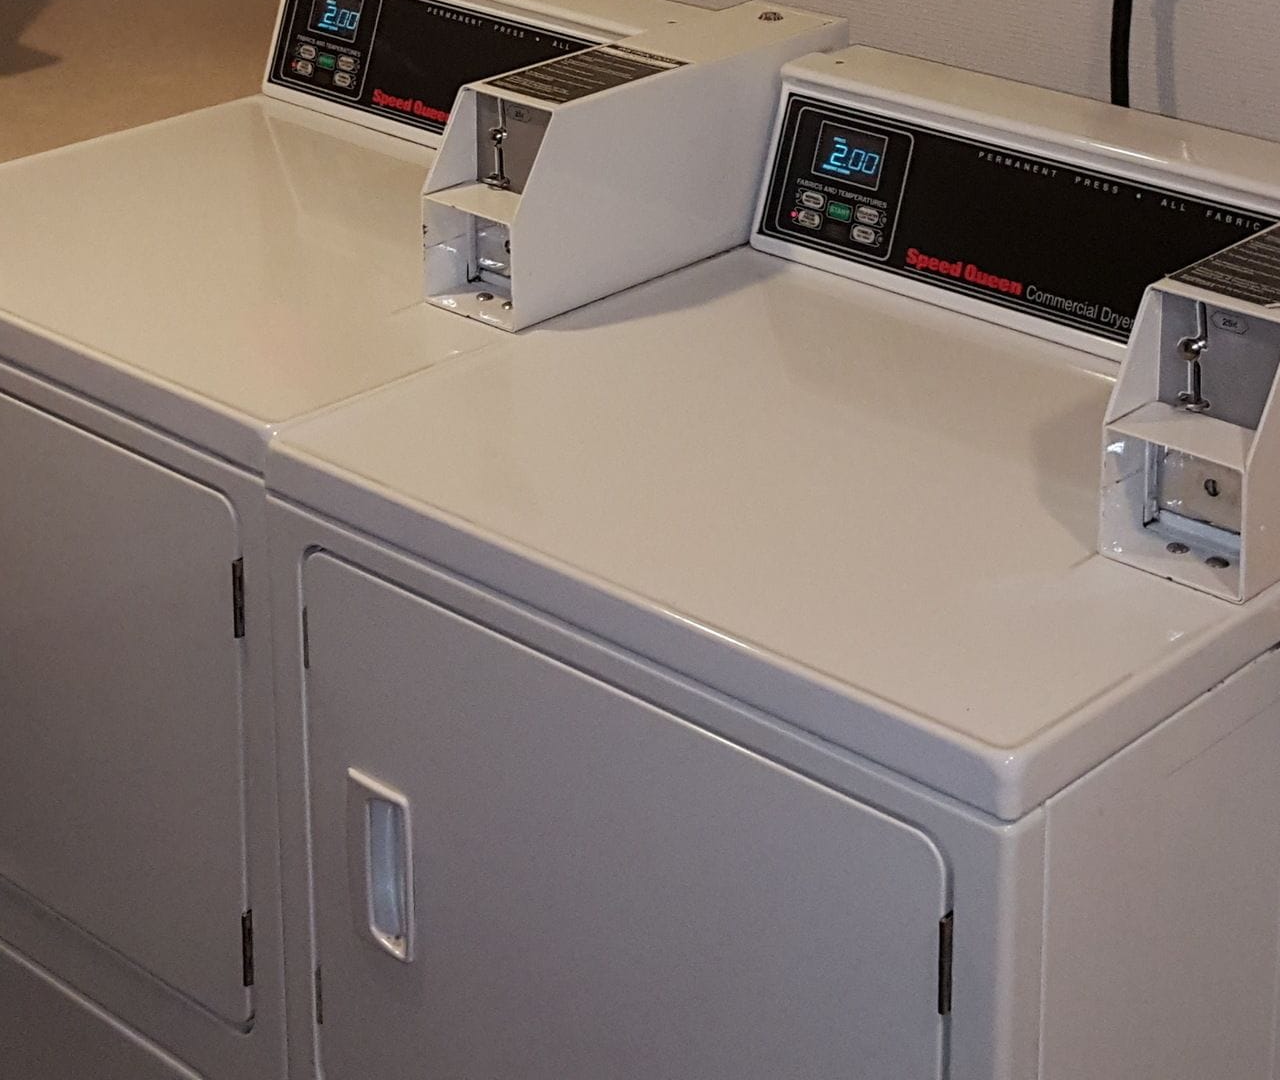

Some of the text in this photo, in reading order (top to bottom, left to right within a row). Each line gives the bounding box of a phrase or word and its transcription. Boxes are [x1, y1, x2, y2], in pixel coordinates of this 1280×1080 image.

[323, 6, 360, 30] 2.00
[427, 6, 570, 51] PERMANENT PRESS ALL
[372, 89, 412, 111] Speed
[830, 144, 879, 174] 2.00
[797, 178, 823, 190] FABRICS
[824, 185, 838, 195] AND
[838, 189, 888, 209] TEMPERATURES
[978, 151, 1260, 231] PERMANENT PRESS ALL FABRIC
[906, 247, 963, 277] Speed
[964, 264, 1023, 295] Queen
[1026, 284, 1100, 319] Commercial
